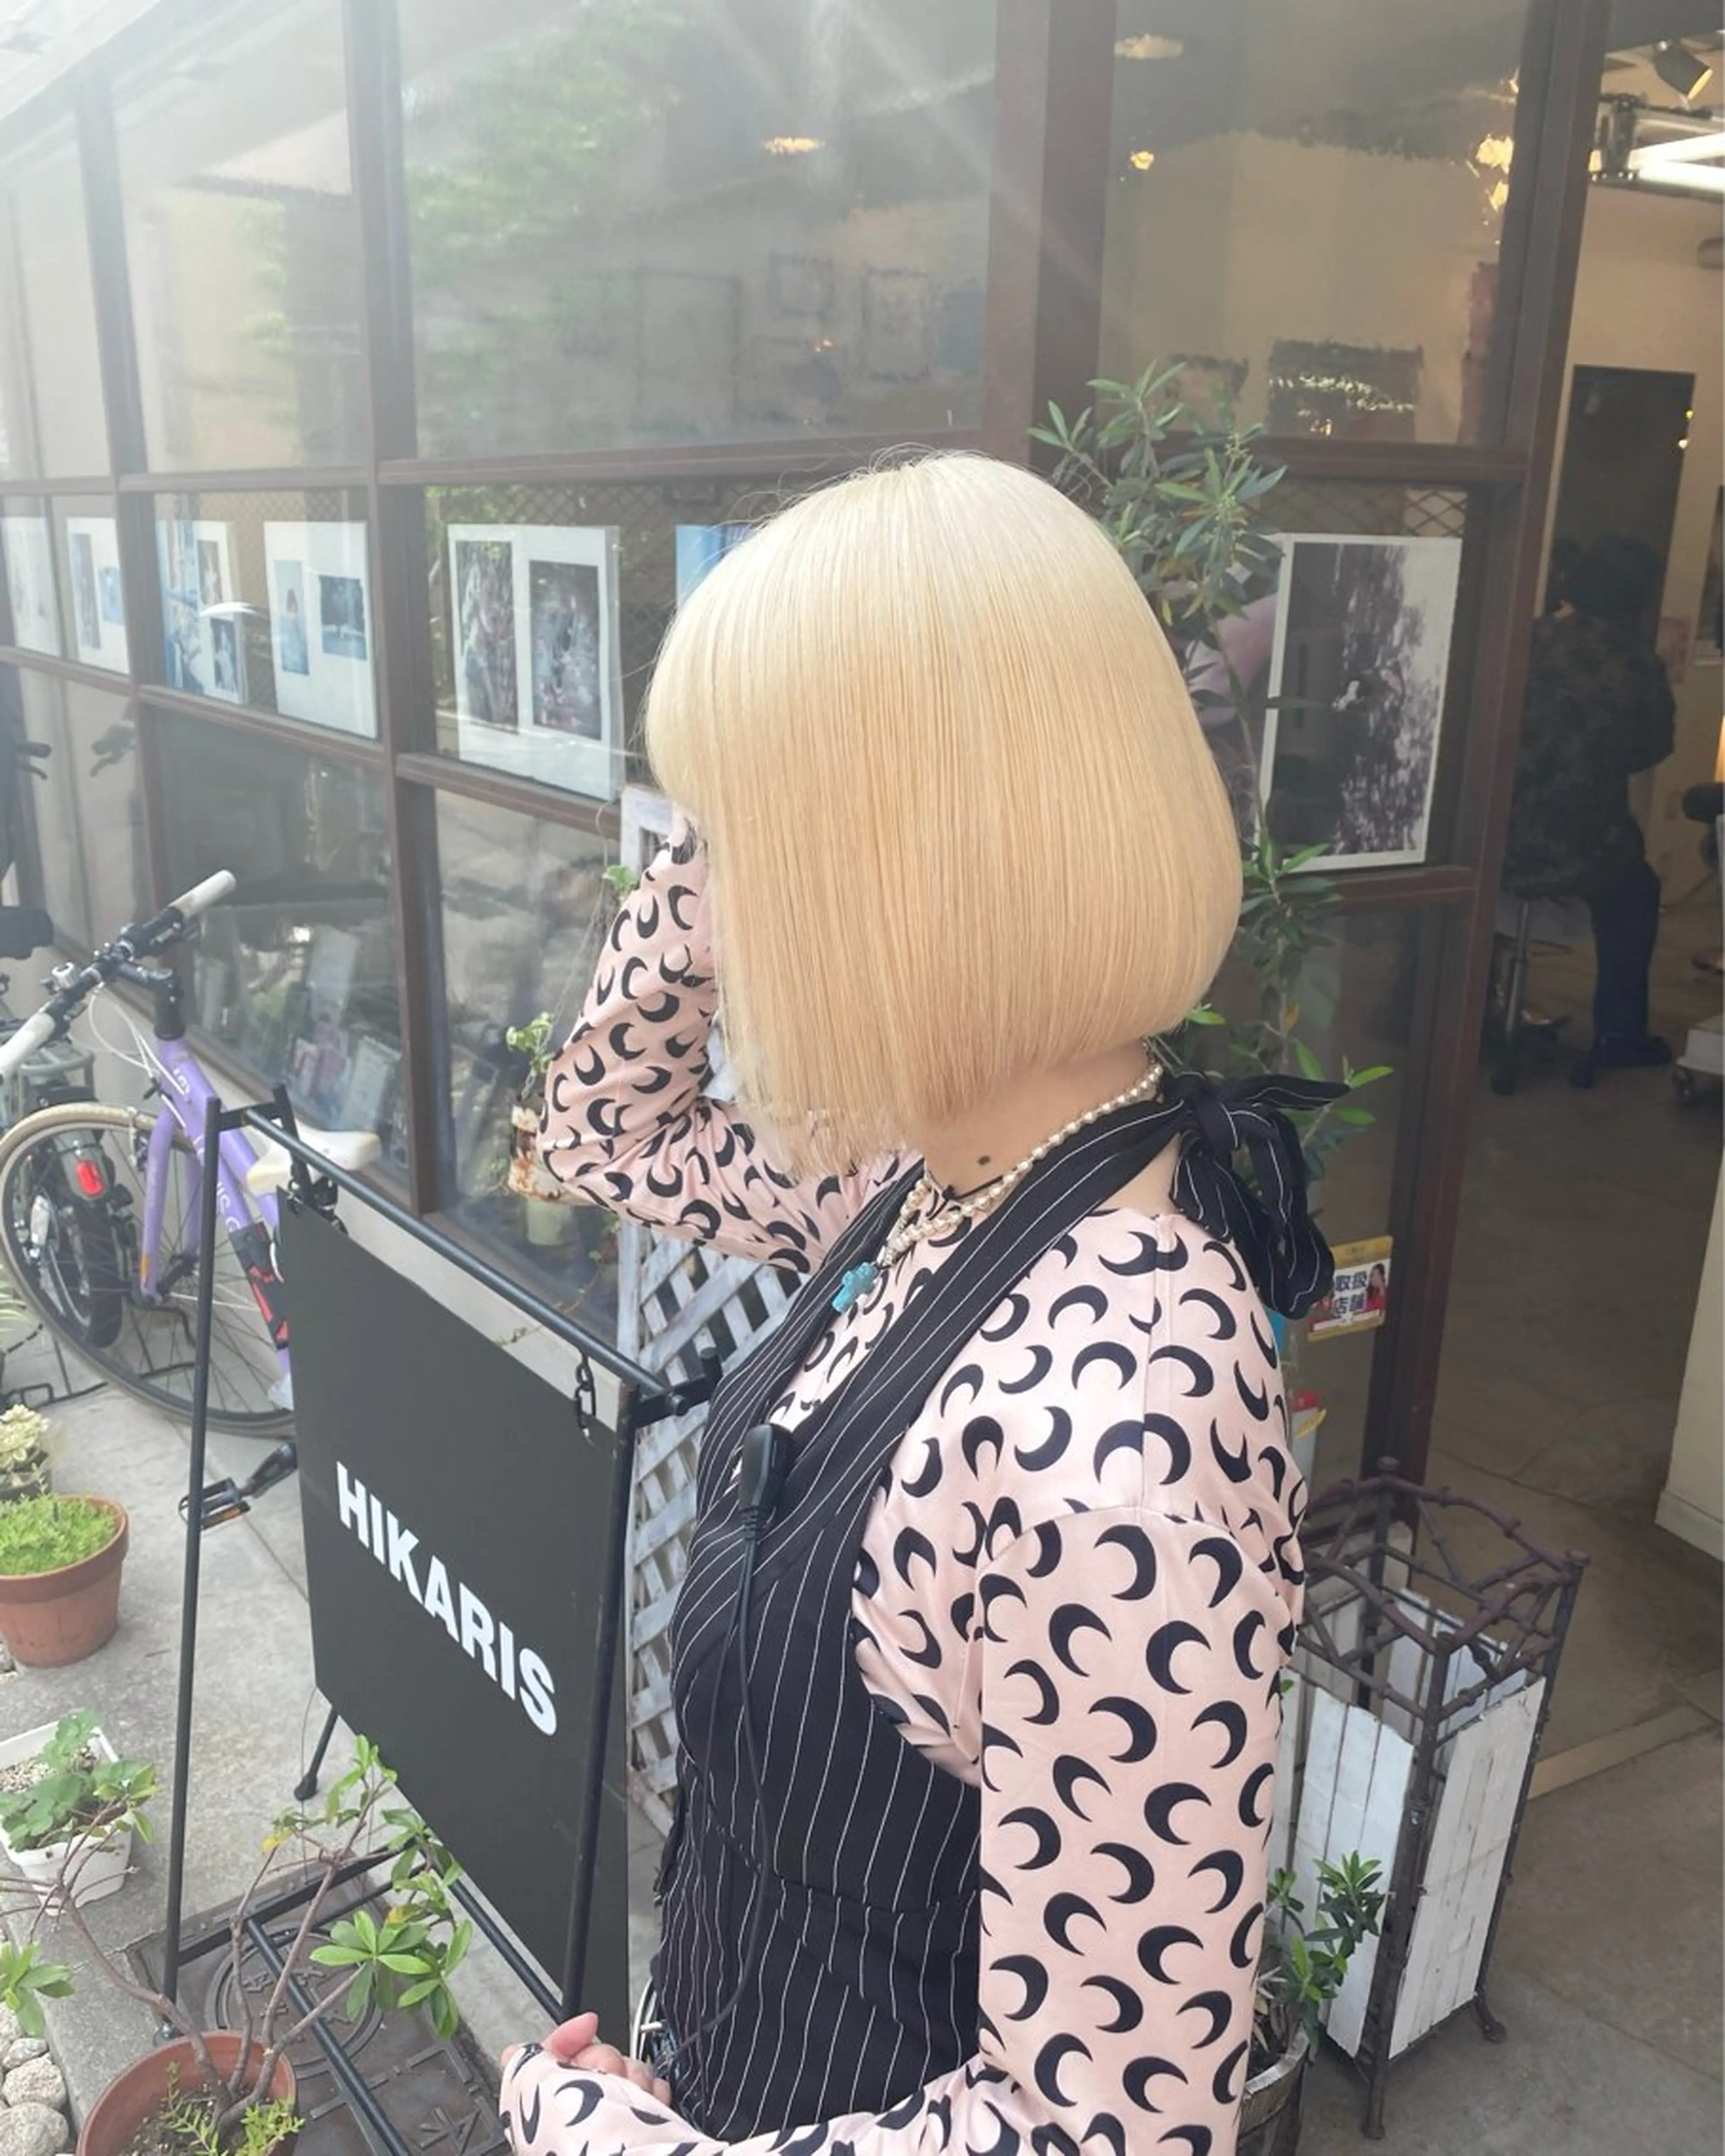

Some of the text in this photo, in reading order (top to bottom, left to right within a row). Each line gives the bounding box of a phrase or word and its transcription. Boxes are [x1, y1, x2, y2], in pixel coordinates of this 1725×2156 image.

[1335, 1271, 1367, 1292] 取扱
[1334, 1293, 1366, 1314] 店舗
[337, 1461, 557, 1735] HIKARIS
